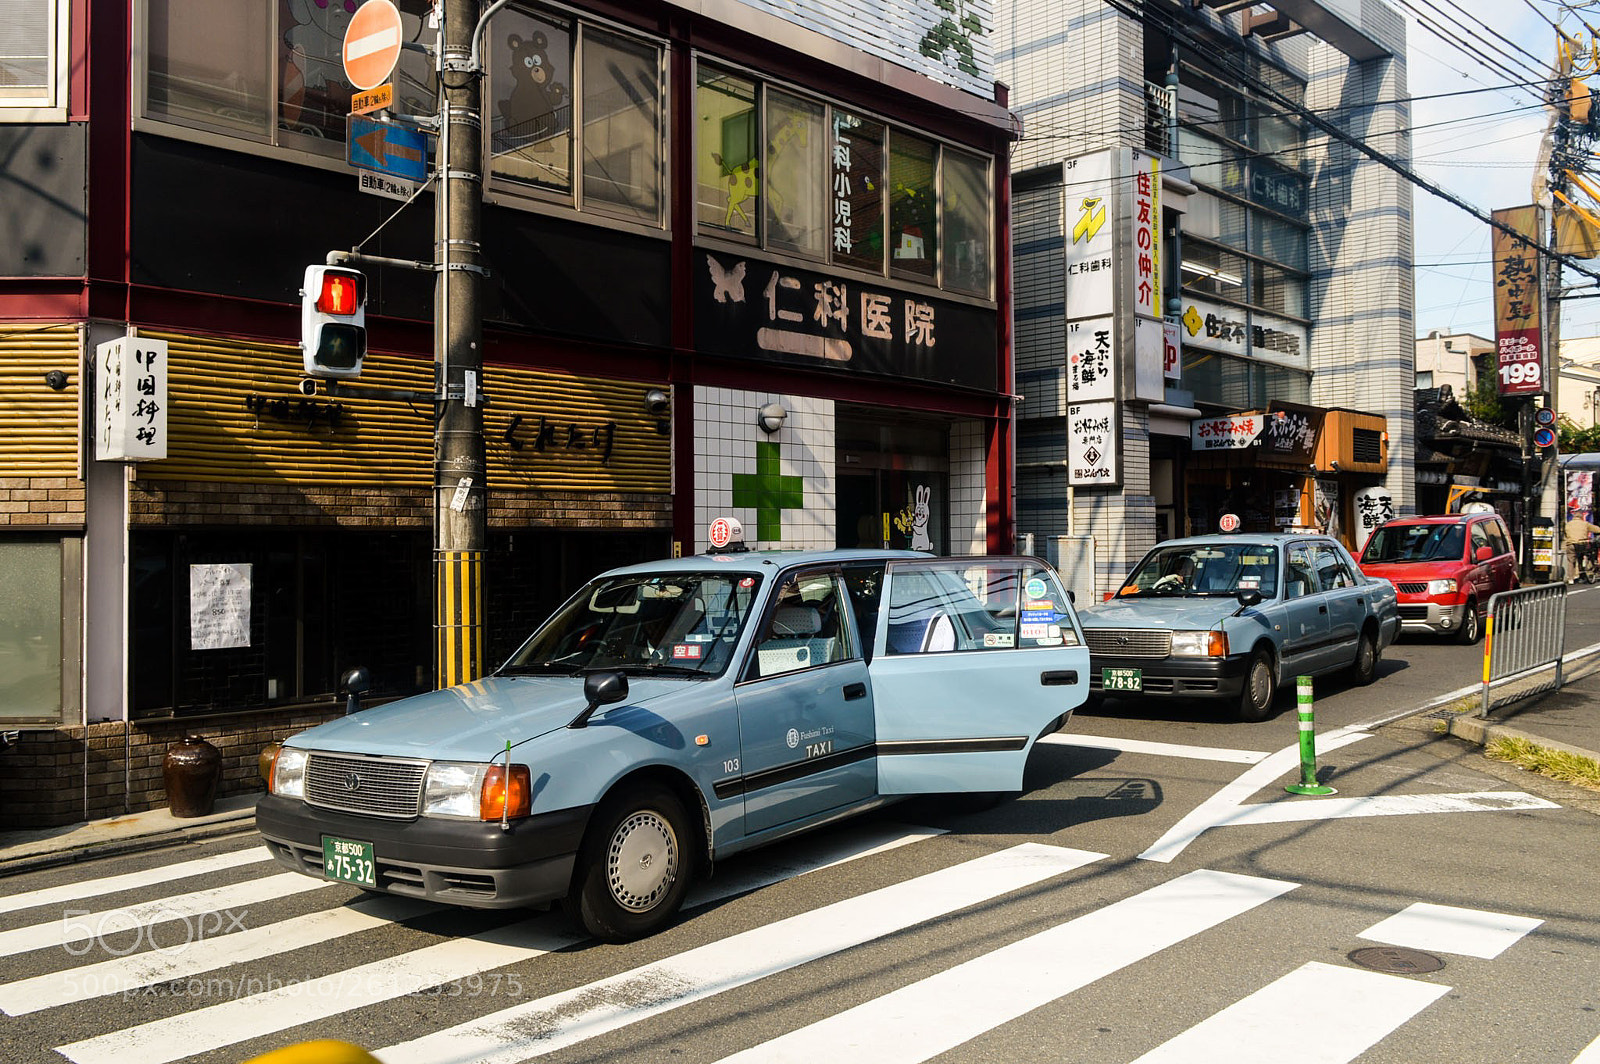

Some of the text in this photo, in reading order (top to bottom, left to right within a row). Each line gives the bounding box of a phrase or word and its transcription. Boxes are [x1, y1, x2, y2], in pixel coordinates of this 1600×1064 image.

[1067, 160, 1078, 169] 3F
[1132, 152, 1140, 161] 2F
[833, 117, 852, 254] 仁科小児科
[1137, 170, 1152, 306] 住友の仲介
[1068, 257, 1112, 275] 仁科歯科
[763, 270, 936, 347] 仁科医院
[1070, 324, 1080, 333] 1F
[1135, 318, 1142, 327] 1F
[1094, 331, 1110, 377] 天ぷら
[1079, 350, 1097, 386] 海鮮
[1070, 407, 1081, 415] BF
[1540, 413, 1550, 421] 30
[1074, 417, 1110, 435] お好み焼
[1199, 418, 1256, 437] お好み焼
[1111, 676, 1140, 689] 78-82
[800, 728, 821, 740] Fushimi
[822, 725, 834, 735] Taxi
[806, 741, 832, 758] TAXI
[723, 758, 740, 773] 103
[334, 855, 374, 884] 75-32
